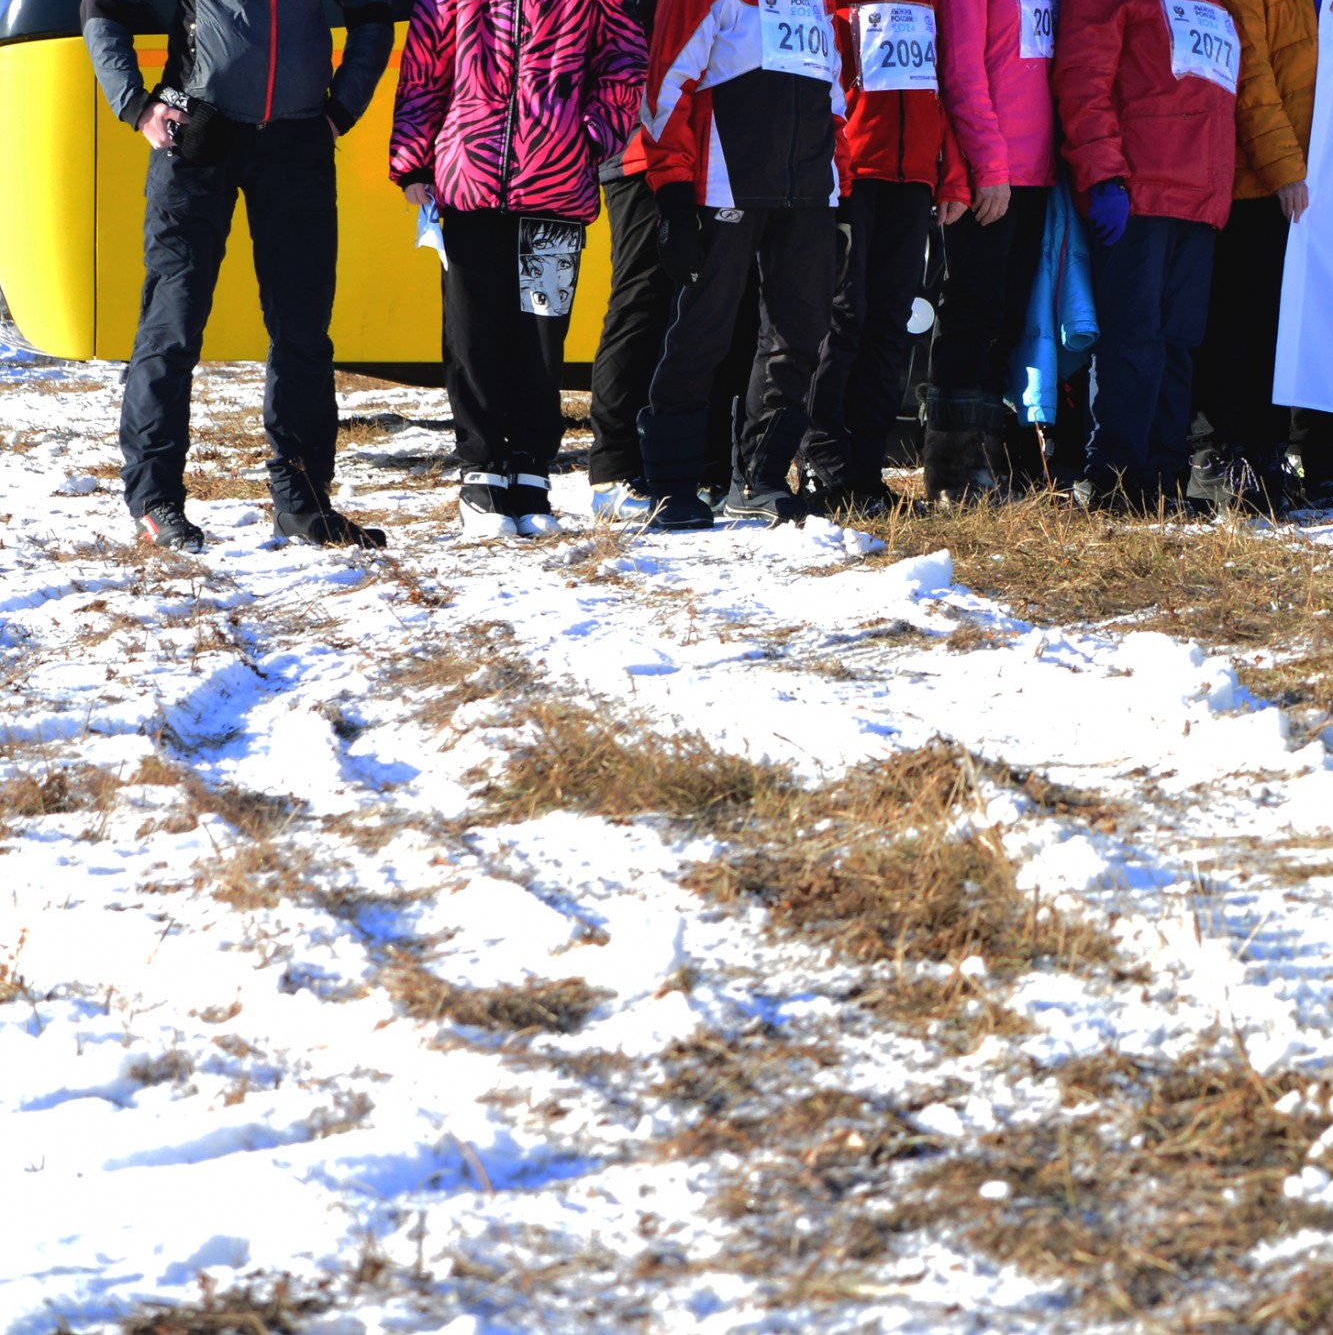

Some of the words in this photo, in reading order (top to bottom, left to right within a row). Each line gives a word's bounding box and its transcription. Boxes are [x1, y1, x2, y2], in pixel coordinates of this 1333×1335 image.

[1034, 8, 1050, 37] 20
[778, 22, 829, 58] 2100
[879, 39, 936, 68] 2094
[1189, 29, 1233, 68] 2077
